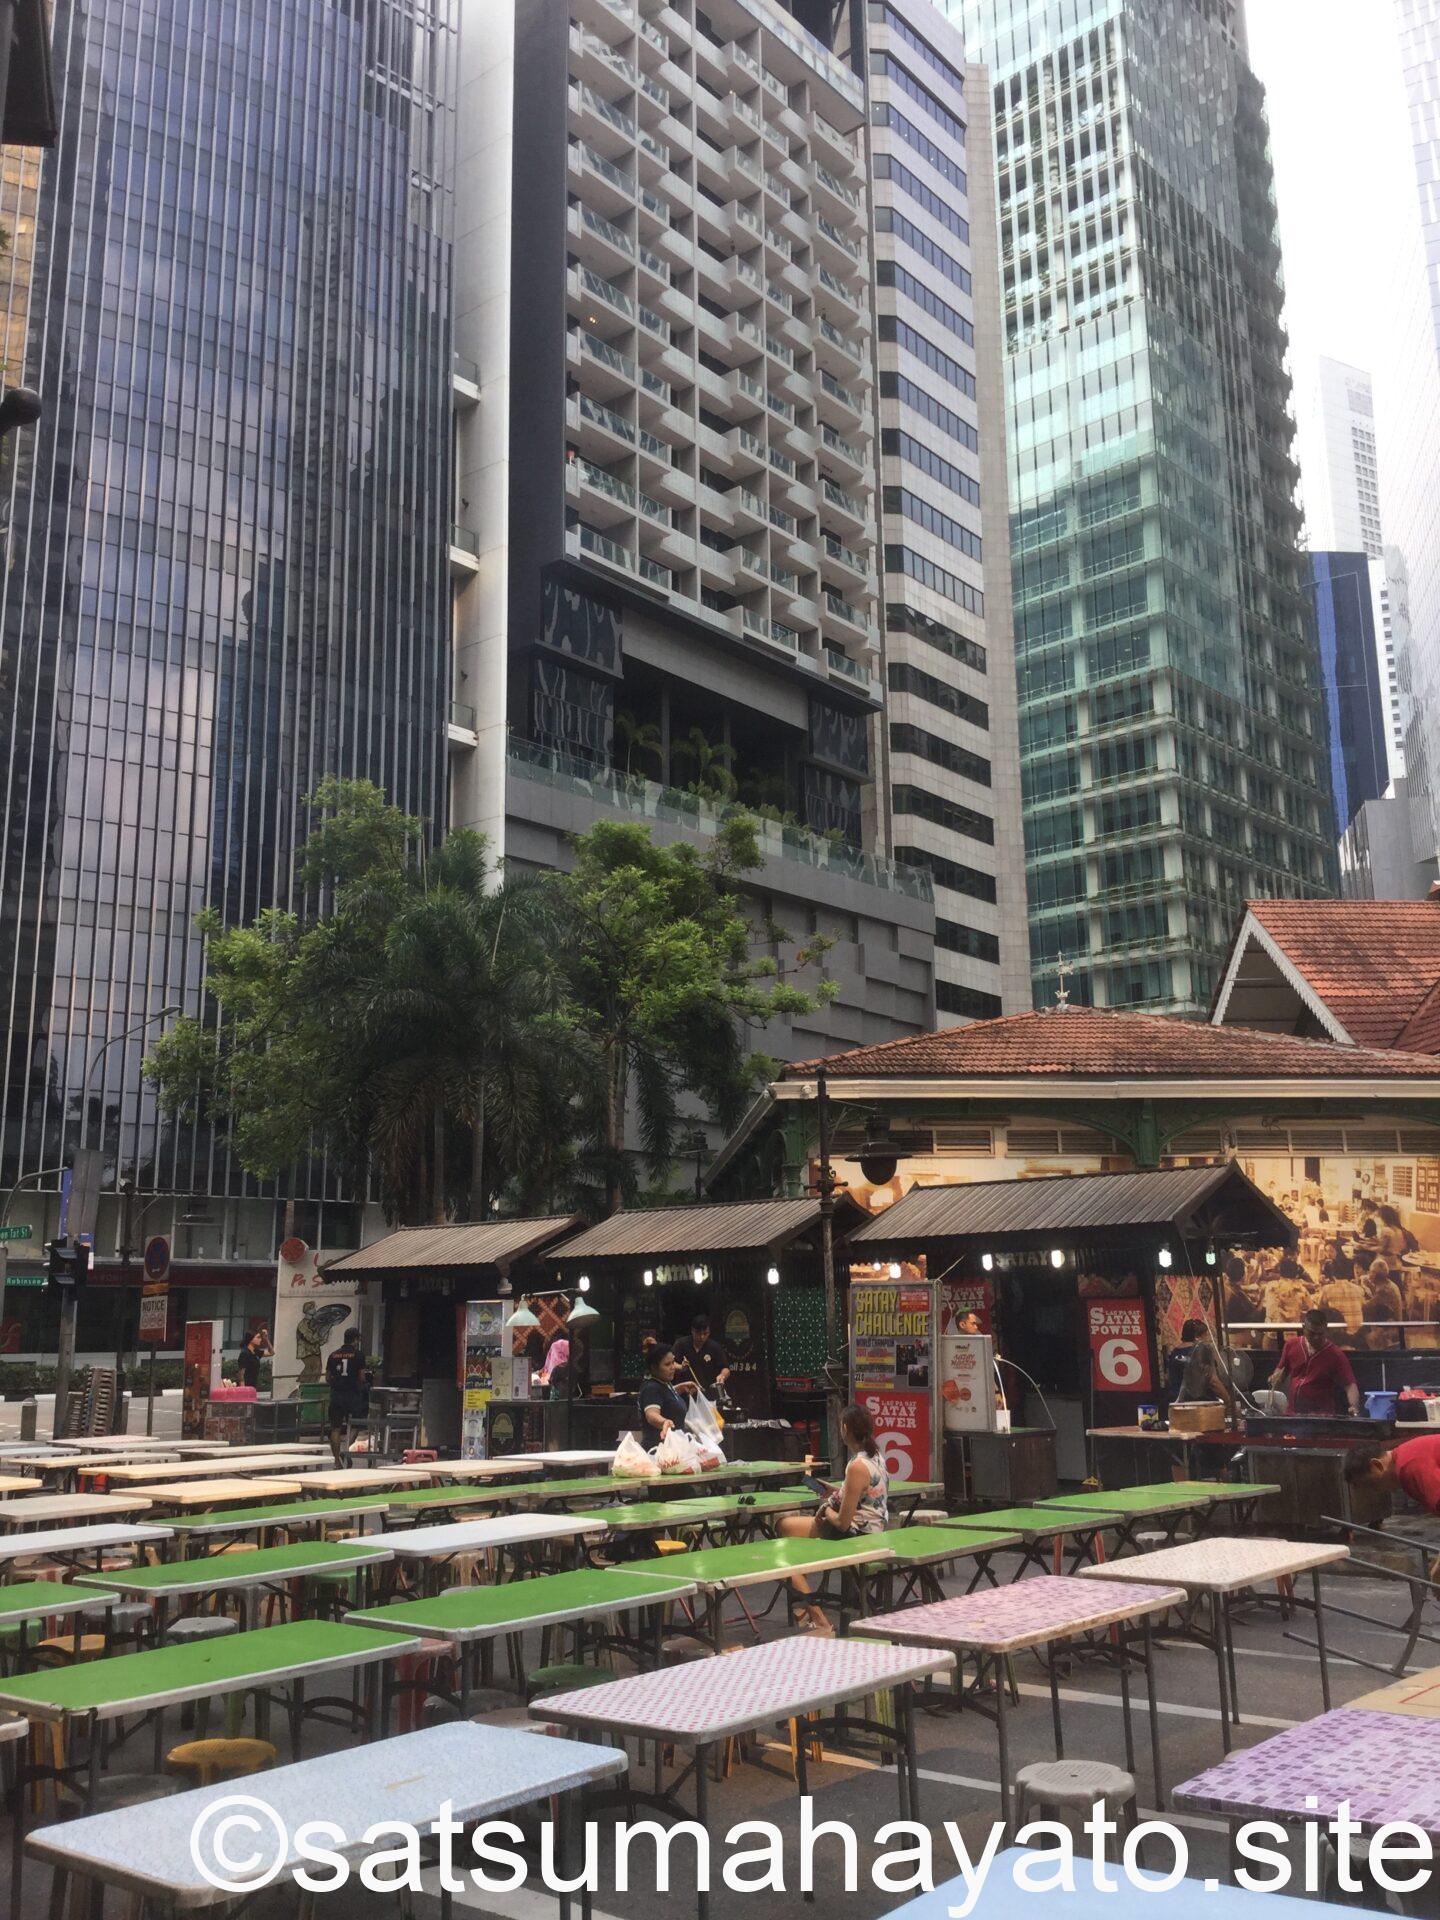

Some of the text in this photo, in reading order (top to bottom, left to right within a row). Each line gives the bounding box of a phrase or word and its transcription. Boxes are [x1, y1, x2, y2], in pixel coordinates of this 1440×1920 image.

[21, 1228, 28, 1238] St
[995, 1250, 1048, 1268] SATAY
[6, 1277, 41, 1286] Robinson
[655, 1264, 696, 1282] SATAY
[857, 1289, 897, 1313] SATAY
[942, 1285, 985, 1301] SATAY
[142, 1299, 165, 1312] NOTICE
[856, 1312, 929, 1337] CHALLENGE
[1090, 1306, 1141, 1325] SATAY
[1090, 1325, 1143, 1335] POWER
[1098, 1338, 1143, 1386] 6
[865, 1396, 917, 1417] SATAY
[875, 1417, 917, 1428] OWER
[875, 1431, 914, 1481] 6
